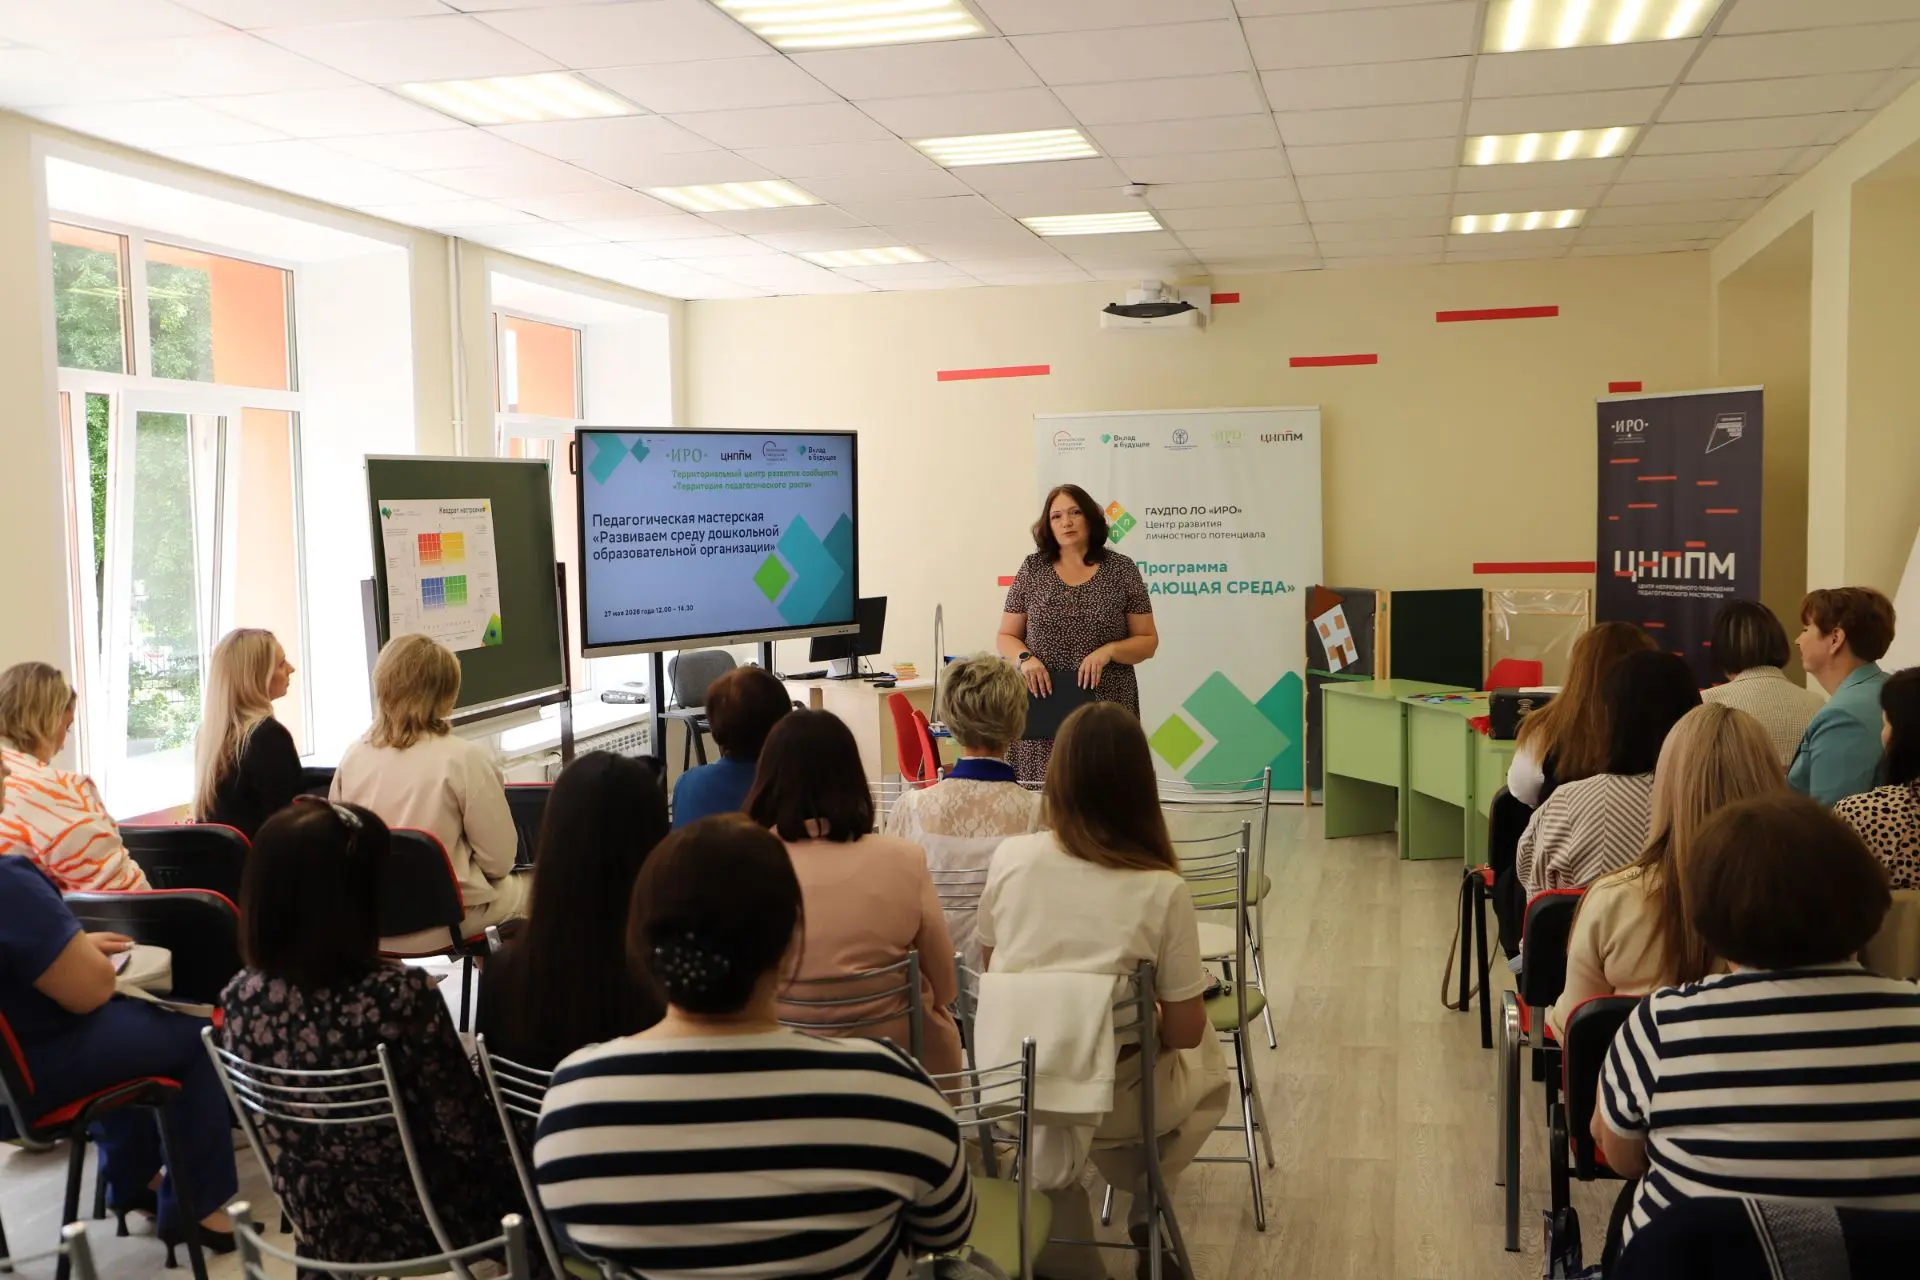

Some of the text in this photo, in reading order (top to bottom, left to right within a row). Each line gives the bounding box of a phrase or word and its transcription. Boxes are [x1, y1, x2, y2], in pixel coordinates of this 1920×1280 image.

[1260, 431, 1303, 443] ЦНППМ
[1119, 441, 1150, 449] будущее
[720, 449, 752, 462] ЦНППМ
[672, 469, 742, 479] Территориальный
[744, 471, 767, 479] центр
[725, 482, 787, 491] педагогического
[1145, 505, 1242, 516] ГАУДПО ЛО «ИРО»
[592, 512, 764, 528] Педагогическая мастерская
[1145, 521, 1222, 530] Центр развития
[592, 524, 779, 544] «Развиваем среду дошкольной
[1145, 531, 1266, 541] личностного потенциала
[592, 543, 776, 562] образовательной организации»
[1614, 541, 1736, 582] ЦНППМ
[1136, 561, 1228, 576] Программа
[1226, 579, 1295, 596] СРЕДА»
